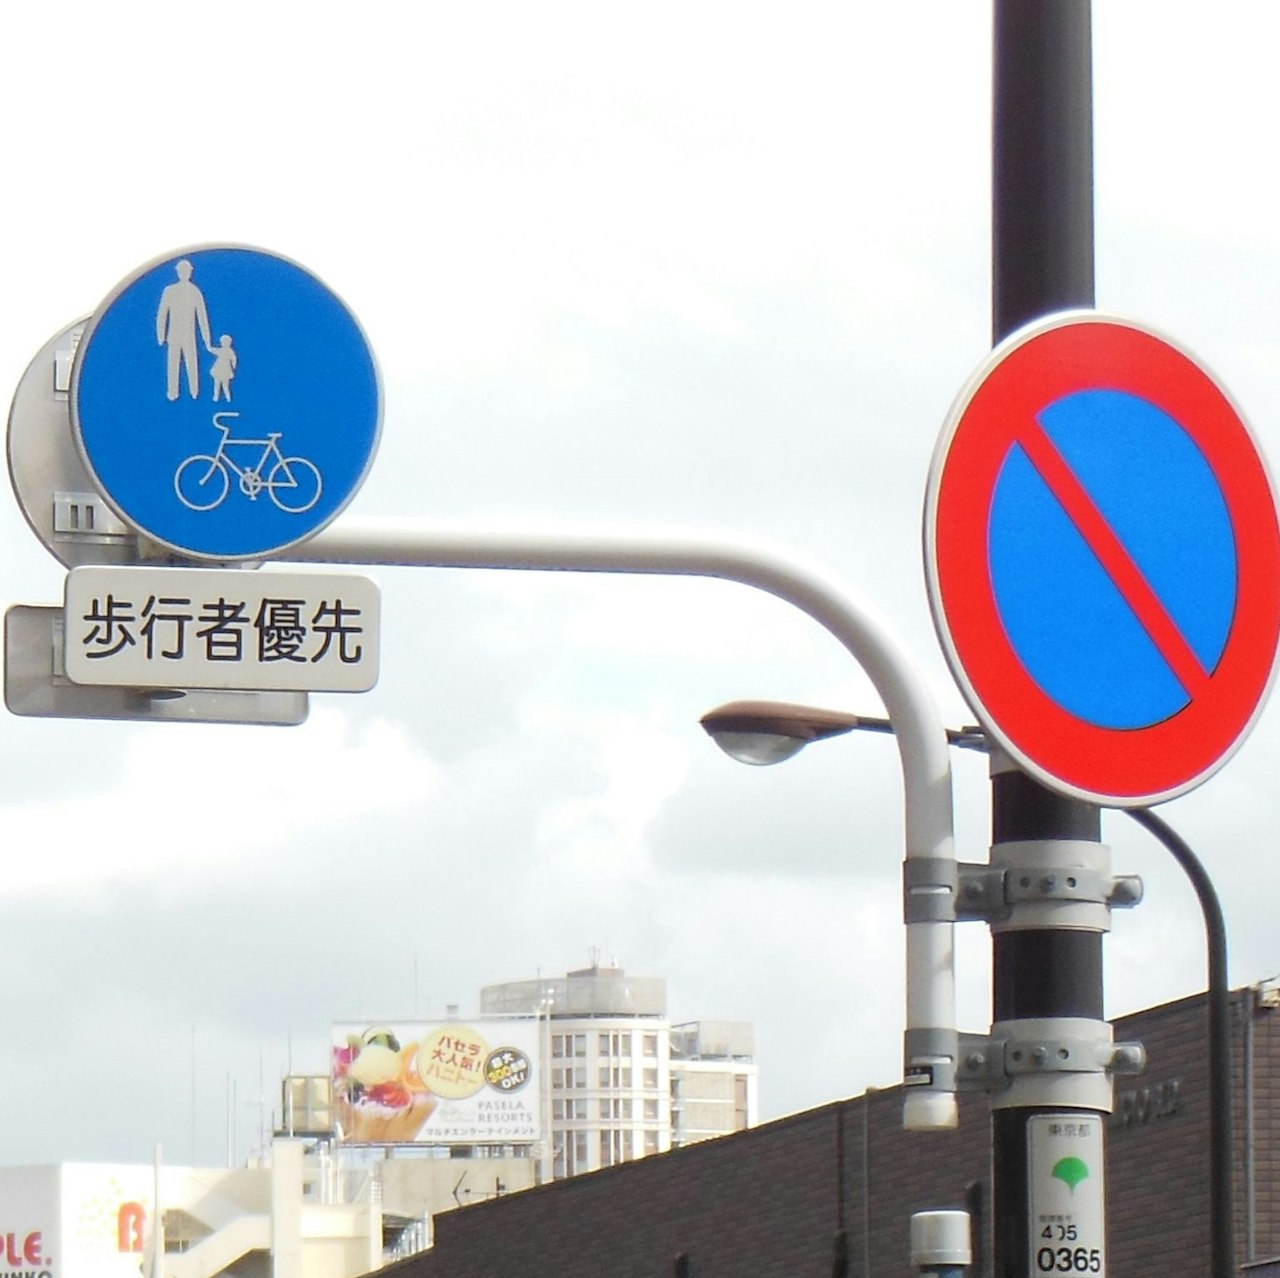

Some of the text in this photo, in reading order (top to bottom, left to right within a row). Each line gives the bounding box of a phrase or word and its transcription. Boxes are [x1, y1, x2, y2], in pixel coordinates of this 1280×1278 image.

[83, 595, 363, 664] 歩行者優先
[478, 1101, 524, 1111] PASELA
[478, 1112, 533, 1122] RESORTS
[1048, 1124, 1091, 1138] 東京都
[1037, 1247, 1101, 1272] 0365
